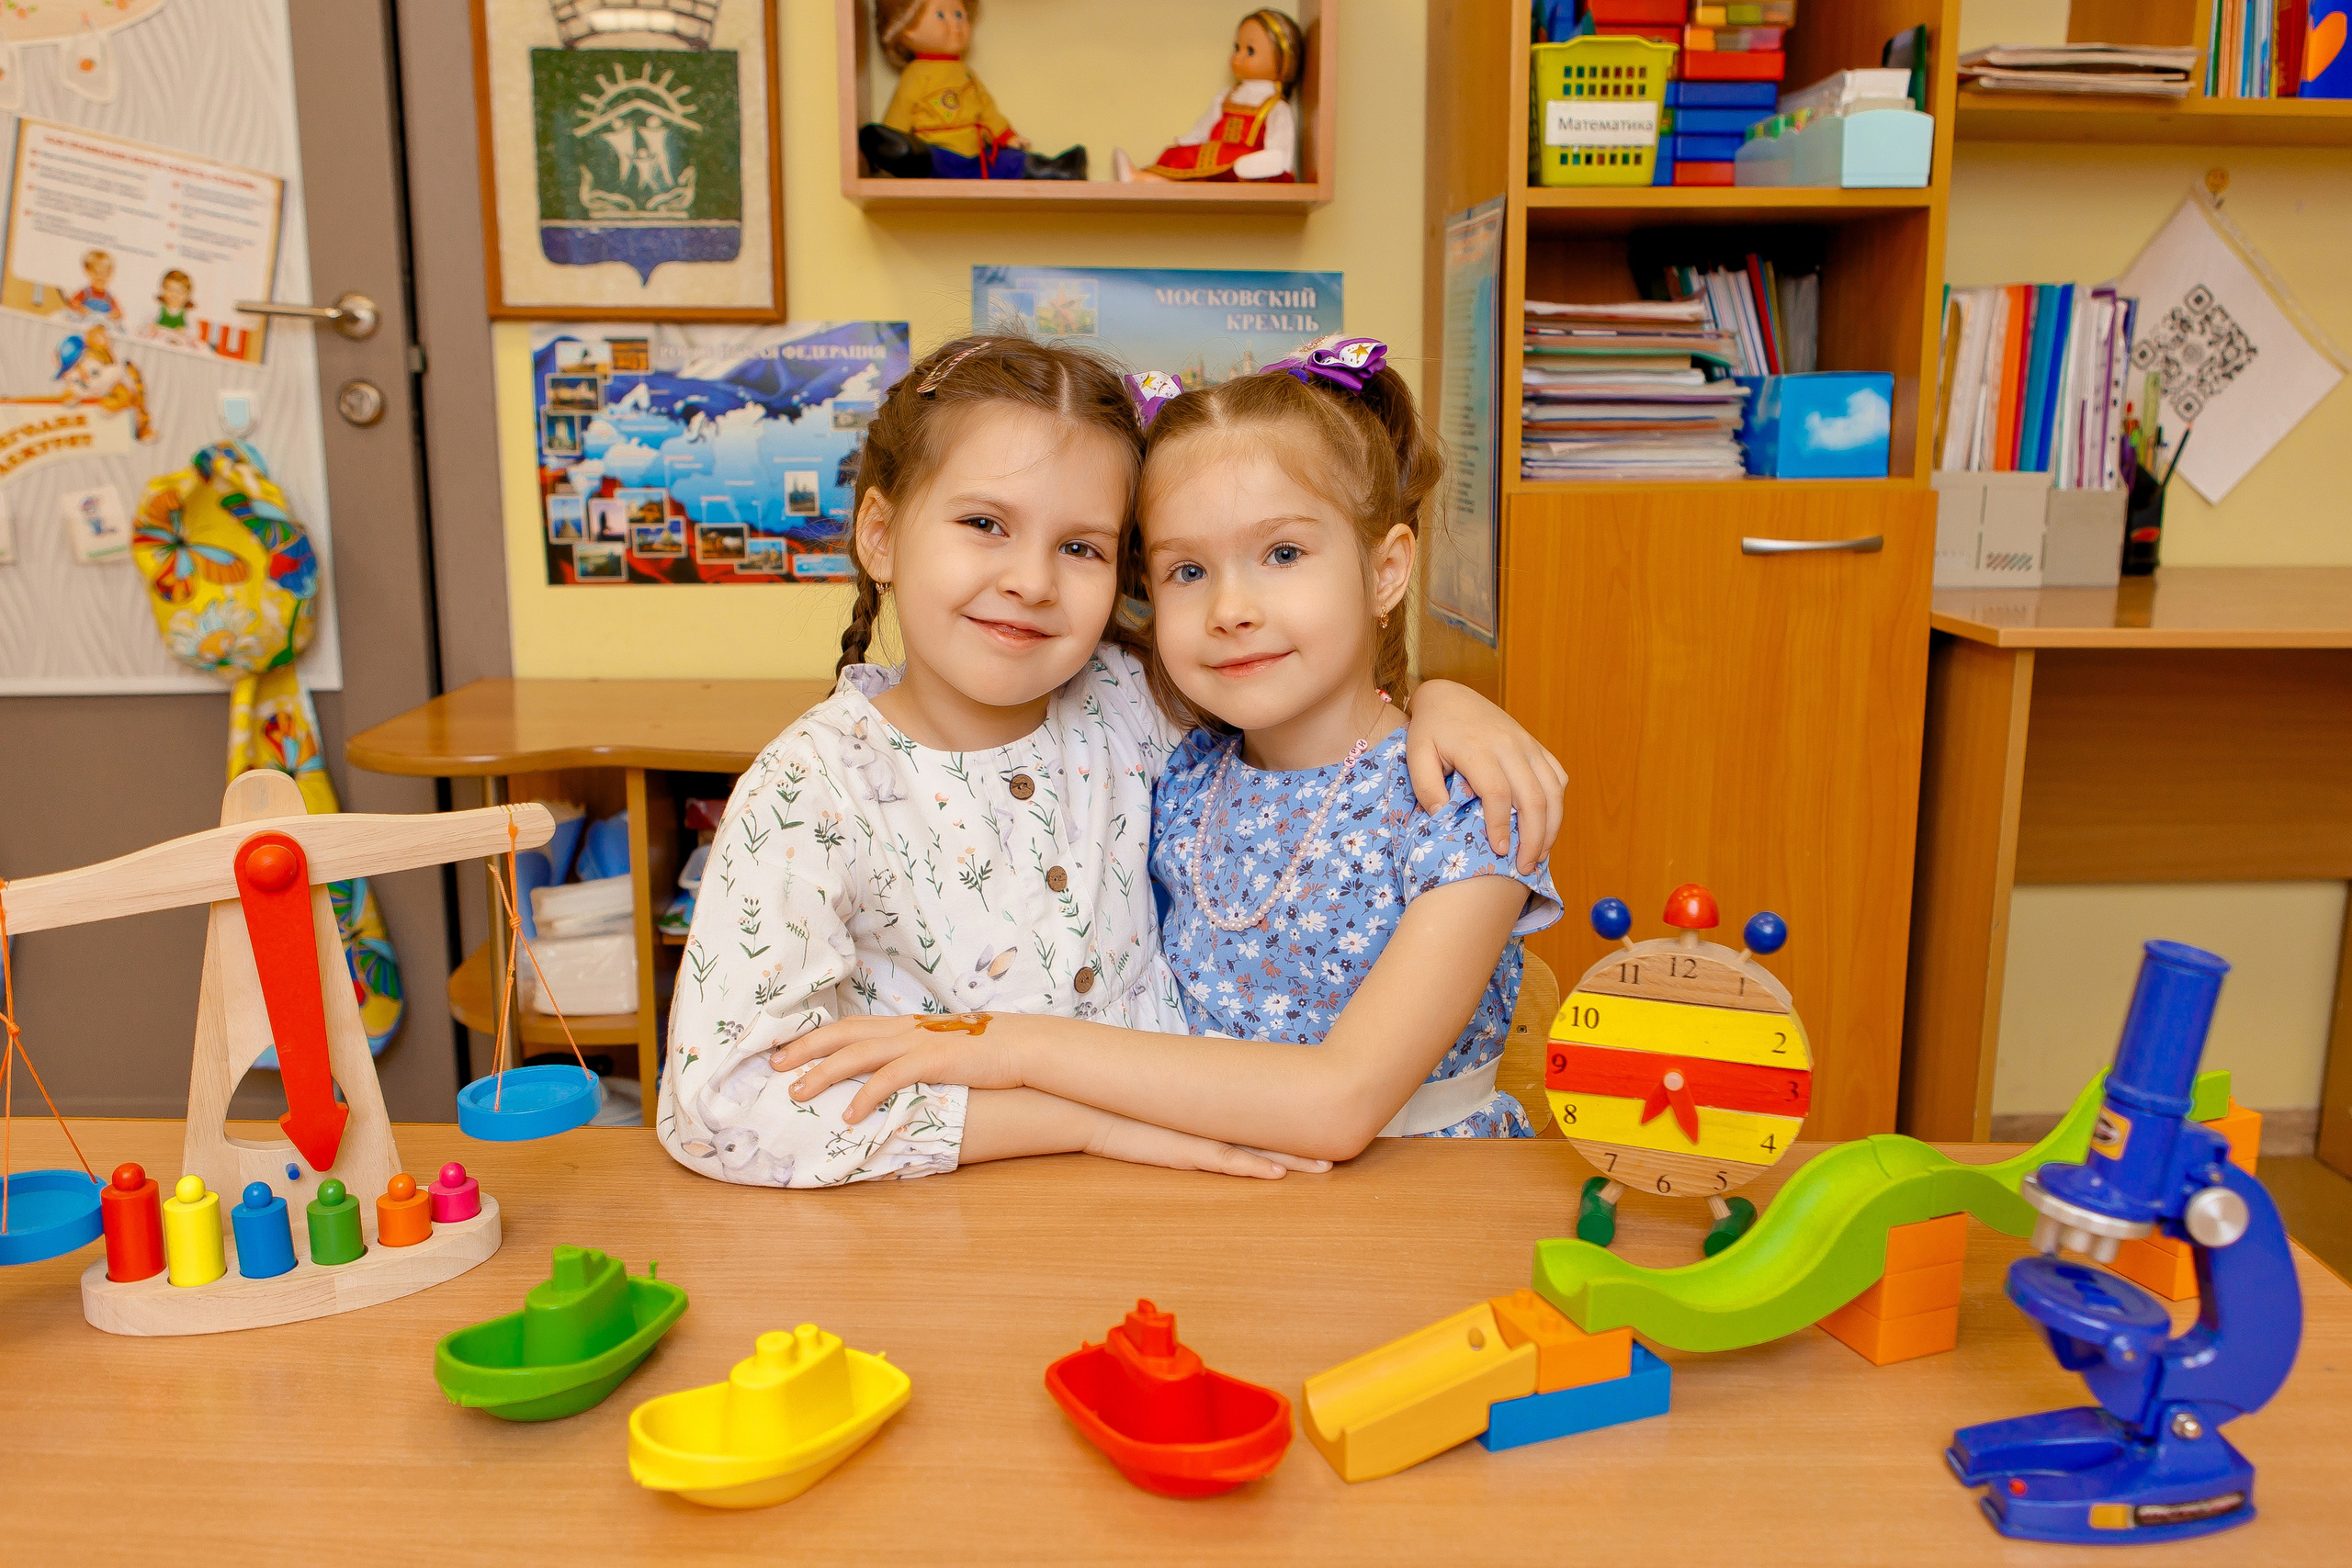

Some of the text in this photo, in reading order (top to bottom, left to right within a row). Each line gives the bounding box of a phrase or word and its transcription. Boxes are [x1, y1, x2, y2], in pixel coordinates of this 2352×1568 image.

[1558, 116, 1653, 130] Математика
[1155, 287, 1317, 308] МОСКОВСКИЙ
[1227, 313, 1319, 332] КРЕМЛЬ
[782, 344, 887, 360] ФЕДЕРАЦИЯ
[1619, 963, 1640, 985] 11
[1668, 957, 1698, 979] 12
[1738, 977, 1746, 997] 1
[1571, 1006, 1600, 1029] 10
[1771, 1032, 1787, 1055] 2
[1551, 1054, 1567, 1074] 9
[1785, 1081, 1799, 1101] 3
[1564, 1104, 1577, 1124] 8
[1760, 1134, 1777, 1154] 4
[1605, 1153, 1619, 1172] 7
[1657, 1174, 1671, 1193] 6
[1714, 1171, 1728, 1190] 5
